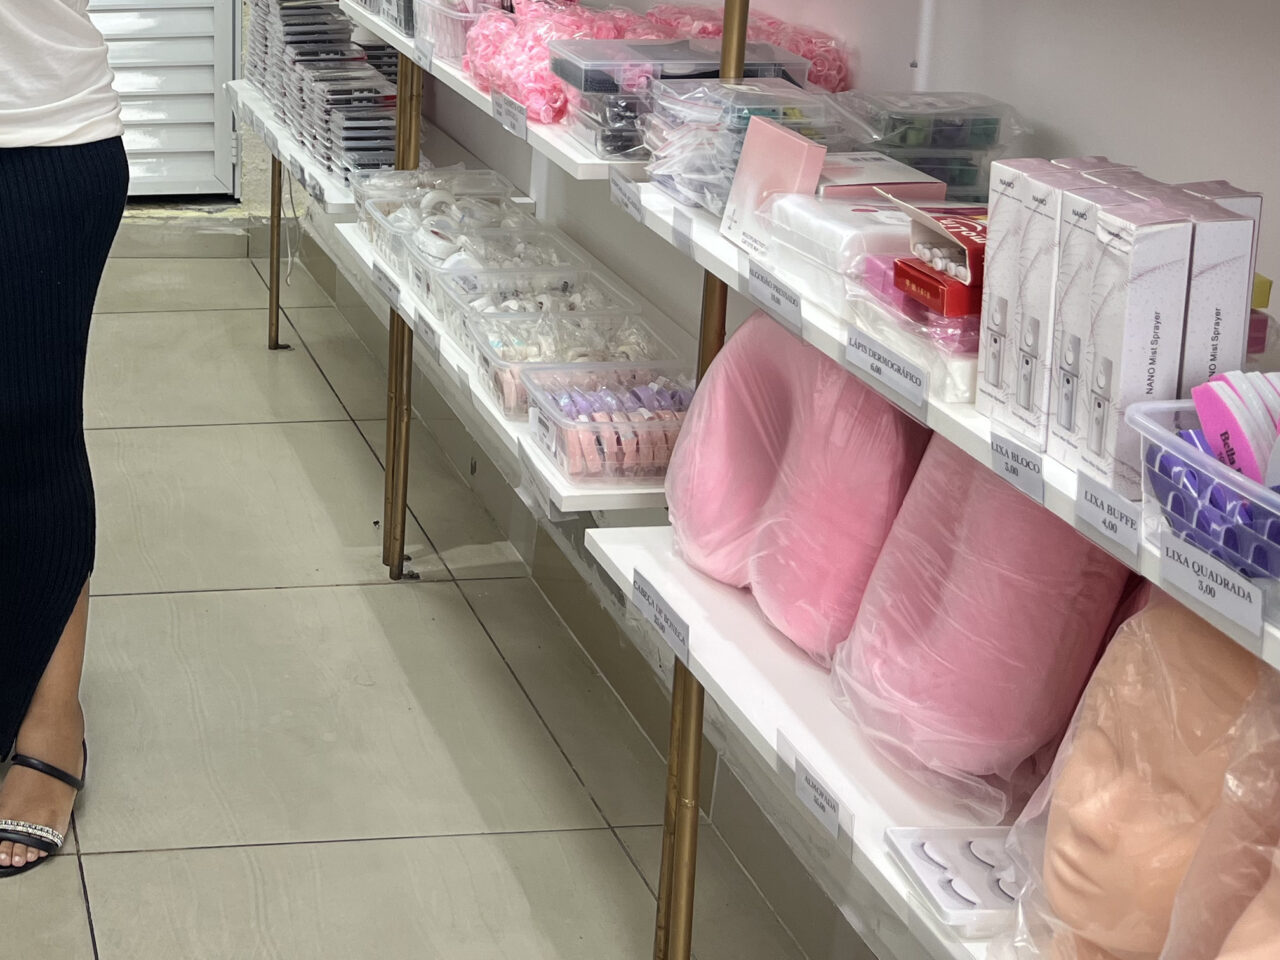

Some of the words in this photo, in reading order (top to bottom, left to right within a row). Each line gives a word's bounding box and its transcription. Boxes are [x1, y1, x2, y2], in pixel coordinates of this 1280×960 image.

[1150, 311, 1161, 345] Sprayer
[1212, 307, 1222, 342] Sprayer
[849, 337, 868, 354] LÁPIS
[1149, 345, 1157, 363] Mist
[1210, 343, 1218, 362] Mist
[1146, 365, 1155, 395] NANO
[991, 441, 1010, 459] LIXA
[1010, 451, 1040, 474] BLOCO
[1219, 431, 1238, 466] Bella
[1084, 490, 1105, 511] LIXA
[1106, 504, 1138, 531] BUFFE
[1101, 518, 1118, 534] 4,00
[1165, 546, 1190, 568] LIXA
[1191, 561, 1253, 604] QUADRADA
[1198, 580, 1216, 599] 3,00
